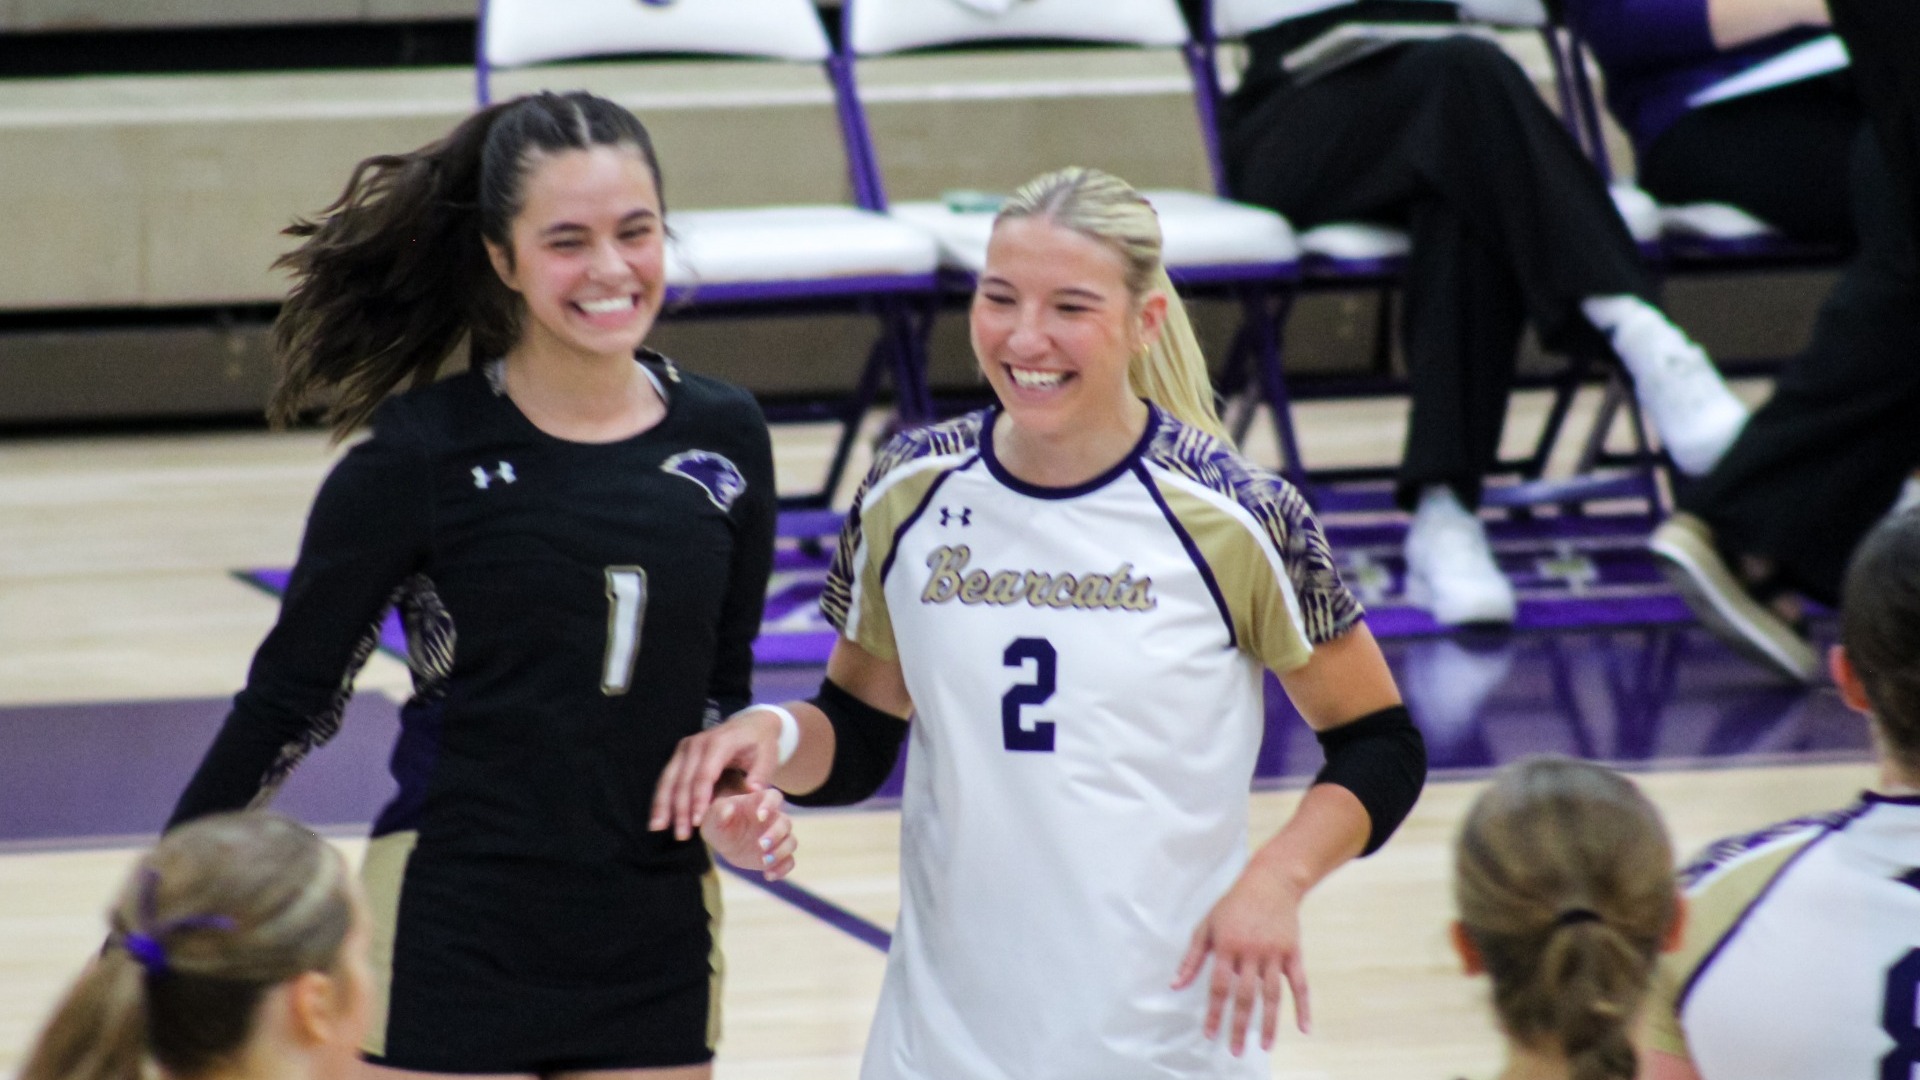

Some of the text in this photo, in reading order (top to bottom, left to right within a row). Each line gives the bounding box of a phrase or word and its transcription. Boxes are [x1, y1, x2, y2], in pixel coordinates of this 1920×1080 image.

[600, 565, 647, 696] 1
[921, 544, 1157, 611] Bearcats
[1001, 637, 1057, 752] 2
